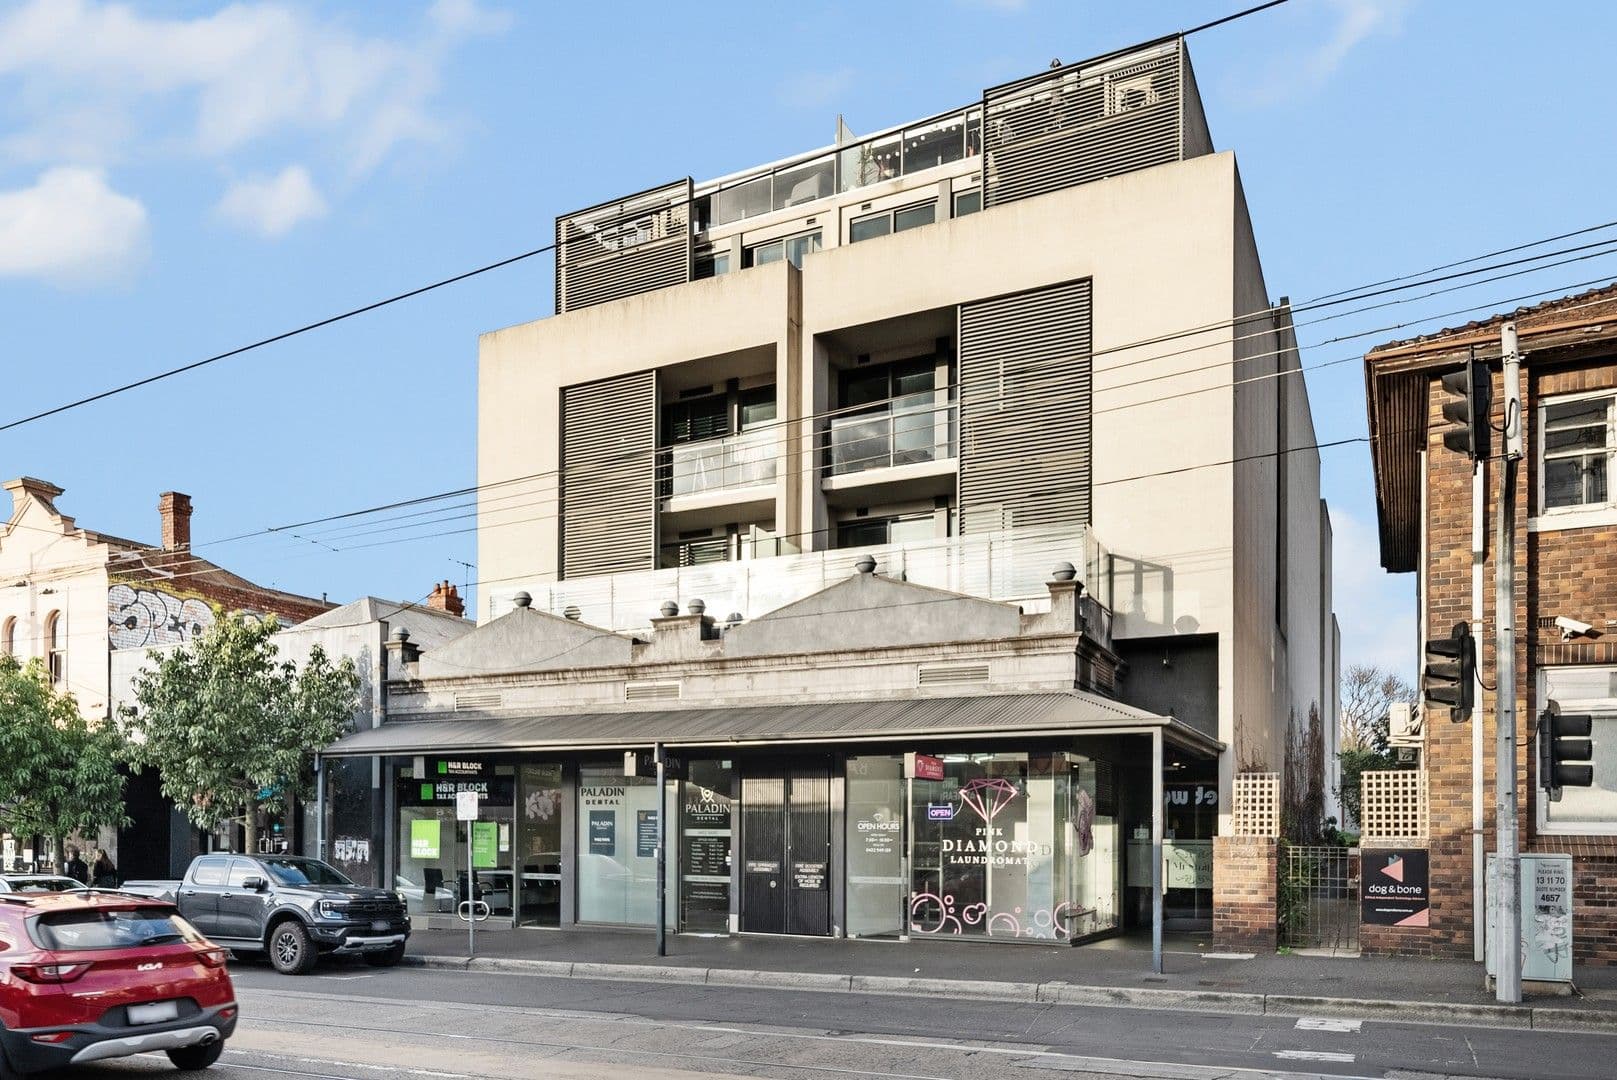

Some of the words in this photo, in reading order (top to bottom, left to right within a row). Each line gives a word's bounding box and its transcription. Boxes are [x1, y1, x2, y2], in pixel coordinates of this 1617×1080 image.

[448, 761, 461, 769] H&R
[462, 762, 482, 770] BLOCK
[436, 783, 455, 792] H&R
[457, 783, 488, 792] BLOCK
[581, 787, 625, 797] PALADIN
[685, 804, 730, 813] PALADIN
[975, 828, 1003, 836] PINK
[411, 839, 429, 848] H&R
[942, 839, 1038, 853] DIAMOND
[411, 848, 438, 857] BLOCK
[950, 855, 1029, 865] LAUNDROMAT
[1537, 876, 1545, 884] 13
[1547, 876, 1553, 884] 11
[1369, 884, 1387, 895] dog
[1388, 885, 1396, 893] &
[1397, 884, 1422, 894] bone
[1541, 894, 1561, 902] 4657
[137, 962, 163, 971] KIA
